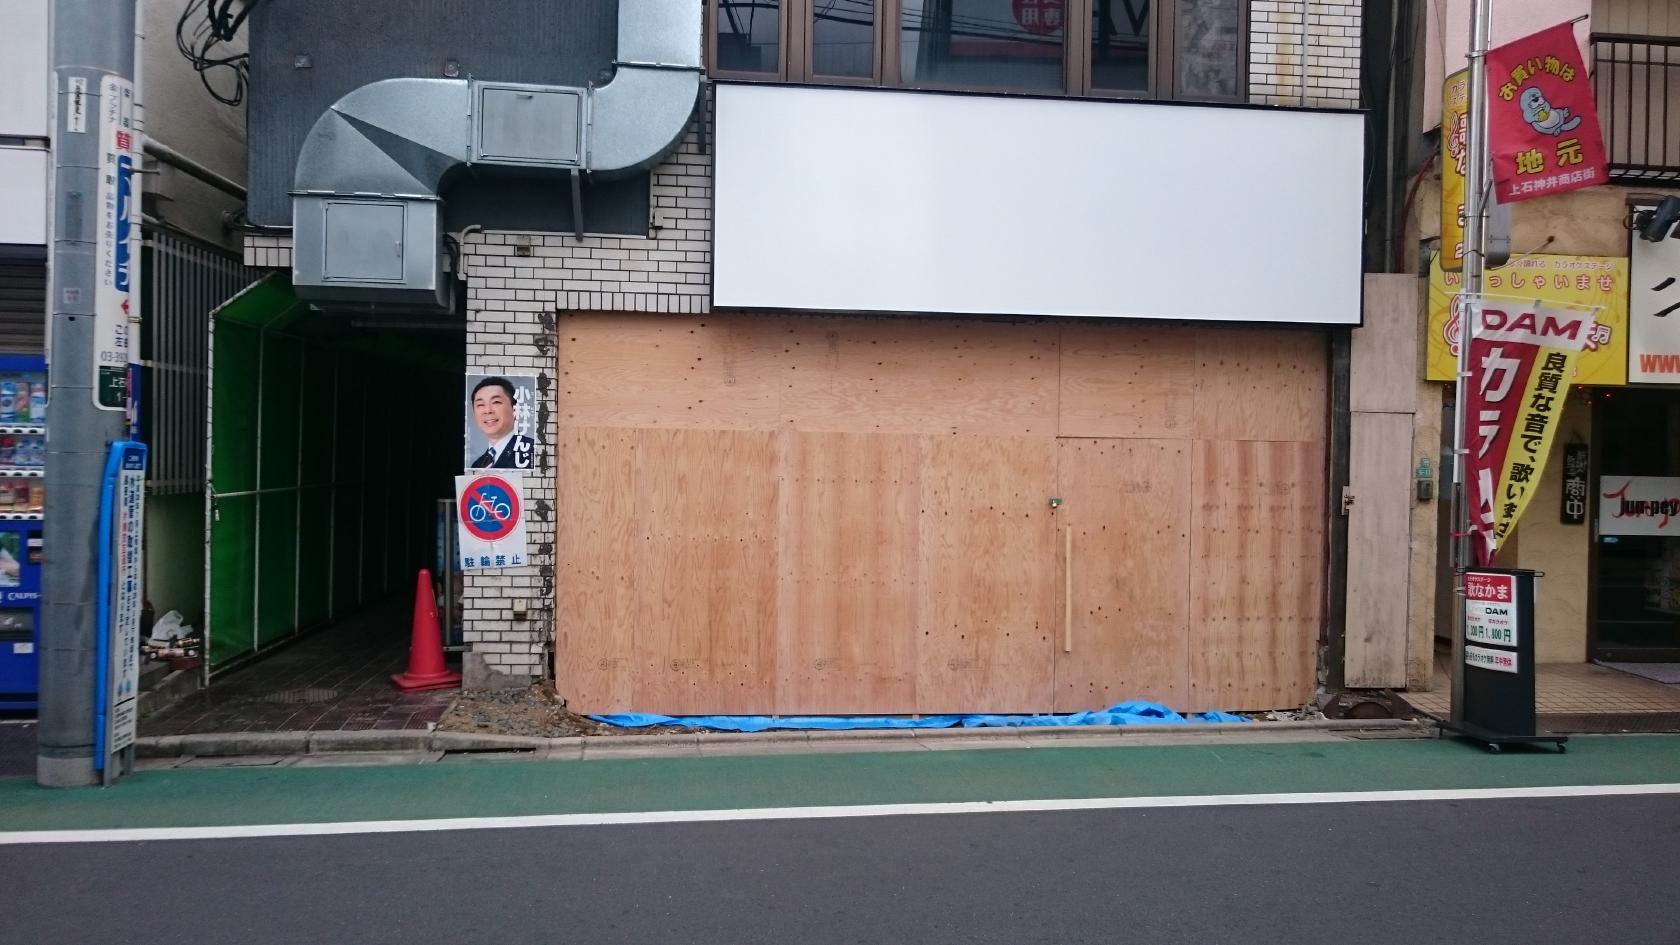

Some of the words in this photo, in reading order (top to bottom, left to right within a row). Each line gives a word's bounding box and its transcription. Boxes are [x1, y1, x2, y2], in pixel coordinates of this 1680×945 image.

[1499, 56, 1575, 101] お買い物は
[1516, 139, 1583, 174] 地元
[1508, 167, 1596, 196] 上石神井商店街
[1445, 271, 1613, 292] いっしゃいませ
[1481, 308, 1583, 340] DAM
[513, 385, 531, 469] 小林けんじ
[464, 554, 522, 568] 駐輪禁止
[1467, 582, 1509, 600] 歌なかま
[1486, 608, 1509, 616] DAM
